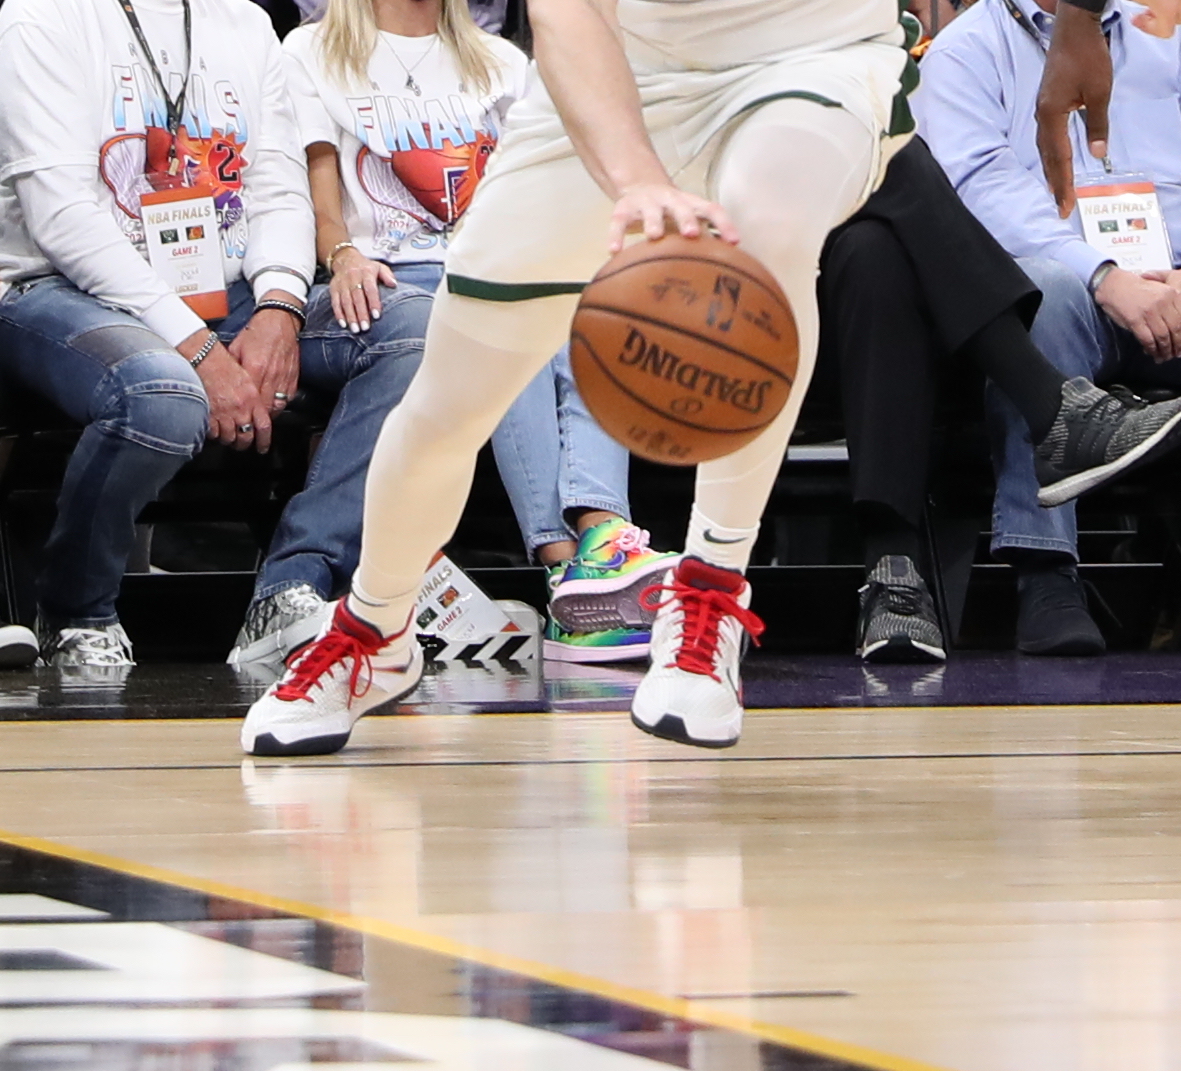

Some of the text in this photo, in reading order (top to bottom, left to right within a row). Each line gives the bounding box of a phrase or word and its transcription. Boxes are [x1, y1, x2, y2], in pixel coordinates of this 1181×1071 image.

[148, 211, 170, 225] NBA
[171, 205, 212, 222] FINALS
[1085, 201, 1154, 215] NBA FINALS
[1112, 236, 1134, 244] GAME
[172, 246, 193, 257] GAME
[618, 326, 773, 414] SPALDING
[417, 564, 454, 603] FINALS
[436, 612, 458, 631] GAME
